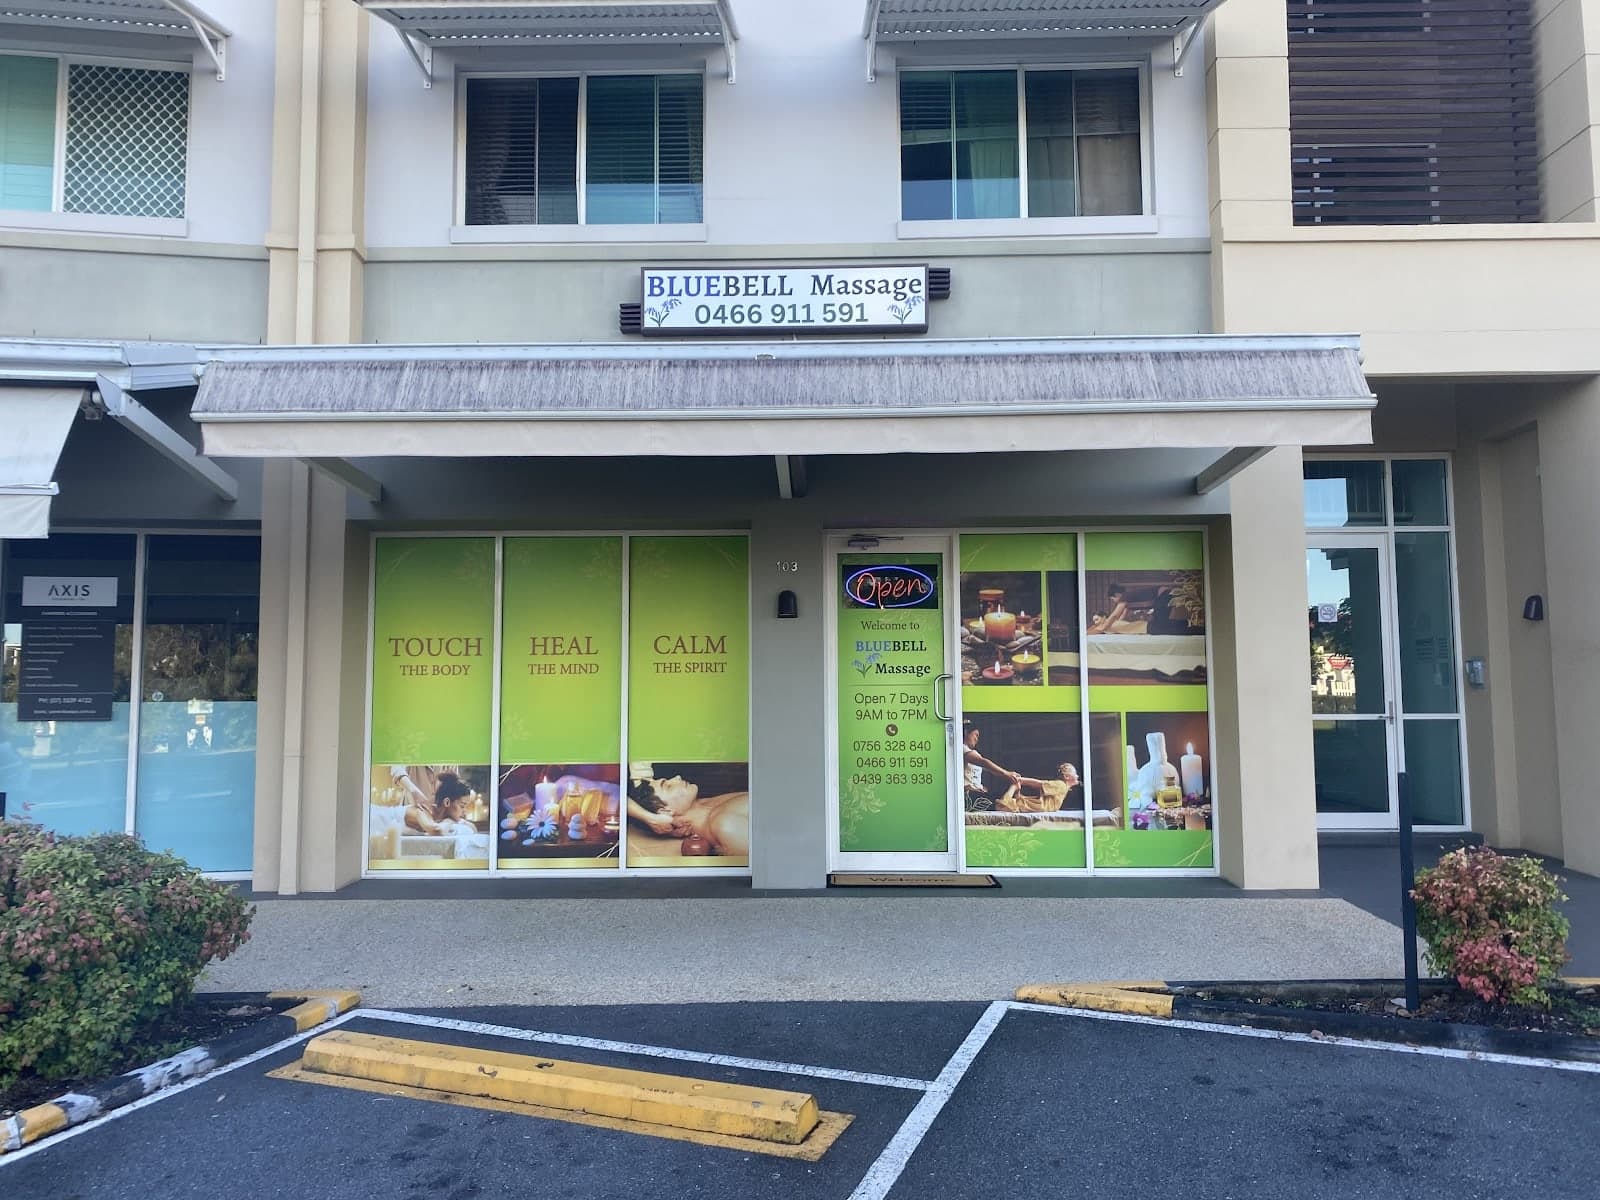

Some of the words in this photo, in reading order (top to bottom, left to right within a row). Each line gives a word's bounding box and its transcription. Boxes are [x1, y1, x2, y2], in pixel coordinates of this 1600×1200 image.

[647, 275, 794, 298] BLUEBELL
[811, 274, 922, 302] Massage
[694, 304, 762, 325] 0466
[770, 303, 815, 324] 911
[822, 302, 869, 323] 591
[776, 560, 799, 573] 103
[48, 585, 91, 597] AXIS
[856, 572, 930, 611] Open
[860, 619, 908, 632] Welcome
[909, 620, 921, 632] to
[388, 637, 483, 658] TOUCH
[528, 636, 600, 657] HEAL
[653, 634, 728, 656] CALM
[855, 640, 928, 652] BLUEBELL
[400, 664, 429, 676] THE
[431, 664, 472, 676] BODY
[528, 663, 557, 675] THE
[560, 663, 600, 675] MIND
[654, 662, 682, 674] THE
[684, 661, 728, 674] SPIRIT
[875, 662, 932, 678] Massage
[854, 692, 887, 707] Open
[889, 692, 897, 704] 7
[899, 692, 930, 708] Days
[855, 709, 884, 721] 9AM
[886, 709, 899, 721] to
[900, 709, 928, 721] 7PM
[853, 740, 882, 752] 0756
[884, 740, 907, 752] 328
[909, 740, 932, 752] 840
[856, 757, 887, 769] 0466
[889, 757, 907, 768] 911
[909, 757, 930, 768] 591
[852, 773, 883, 785] 0439
[885, 773, 908, 785] 363
[910, 773, 934, 785] 938
